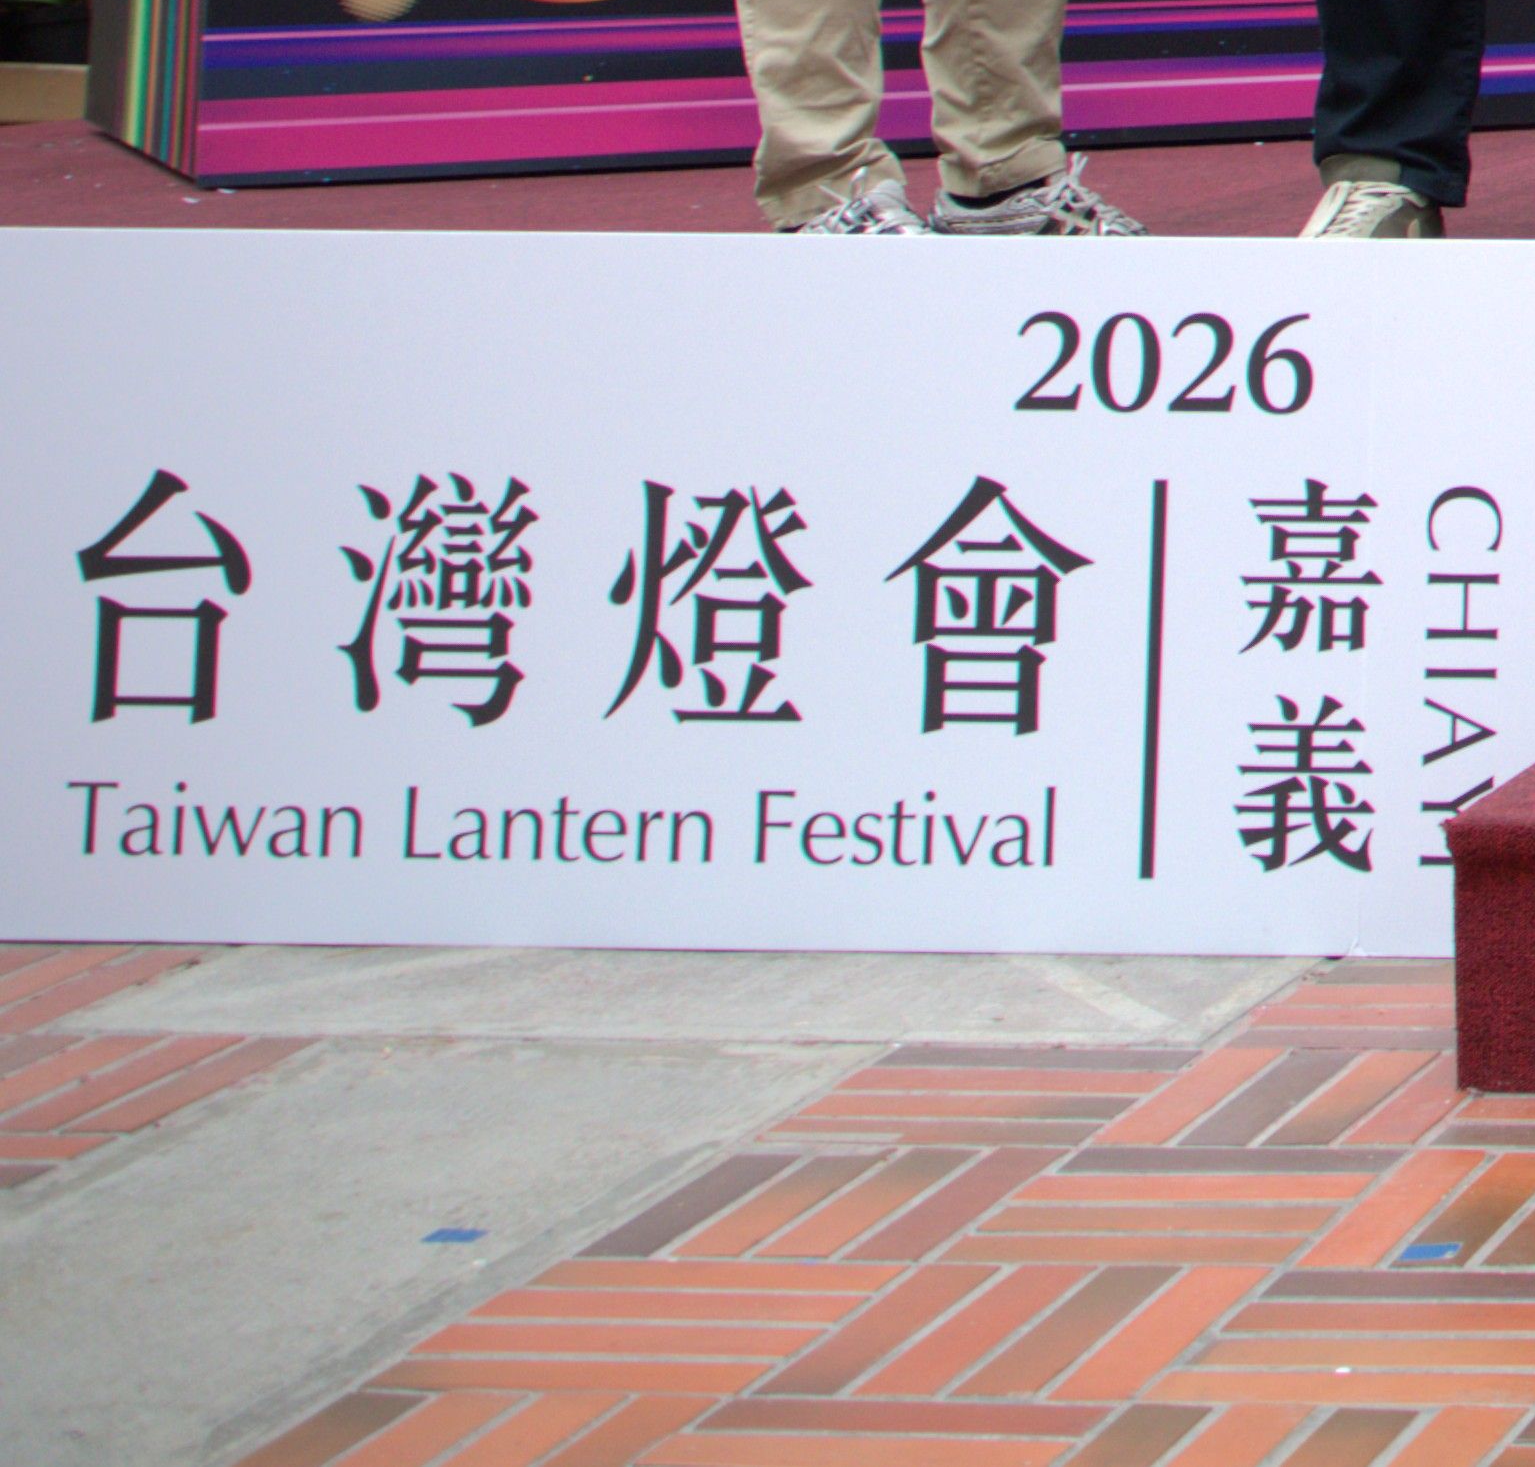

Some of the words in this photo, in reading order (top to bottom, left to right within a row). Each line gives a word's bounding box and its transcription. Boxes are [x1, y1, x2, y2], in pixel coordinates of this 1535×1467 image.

[1013, 311, 1316, 416] 2026
[75, 467, 1097, 737] 台灣燈會
[1236, 476, 1385, 875] 嘉義
[67, 780, 364, 861] Taiwan
[404, 785, 715, 863] Lantern
[755, 785, 1057, 869] Festival
